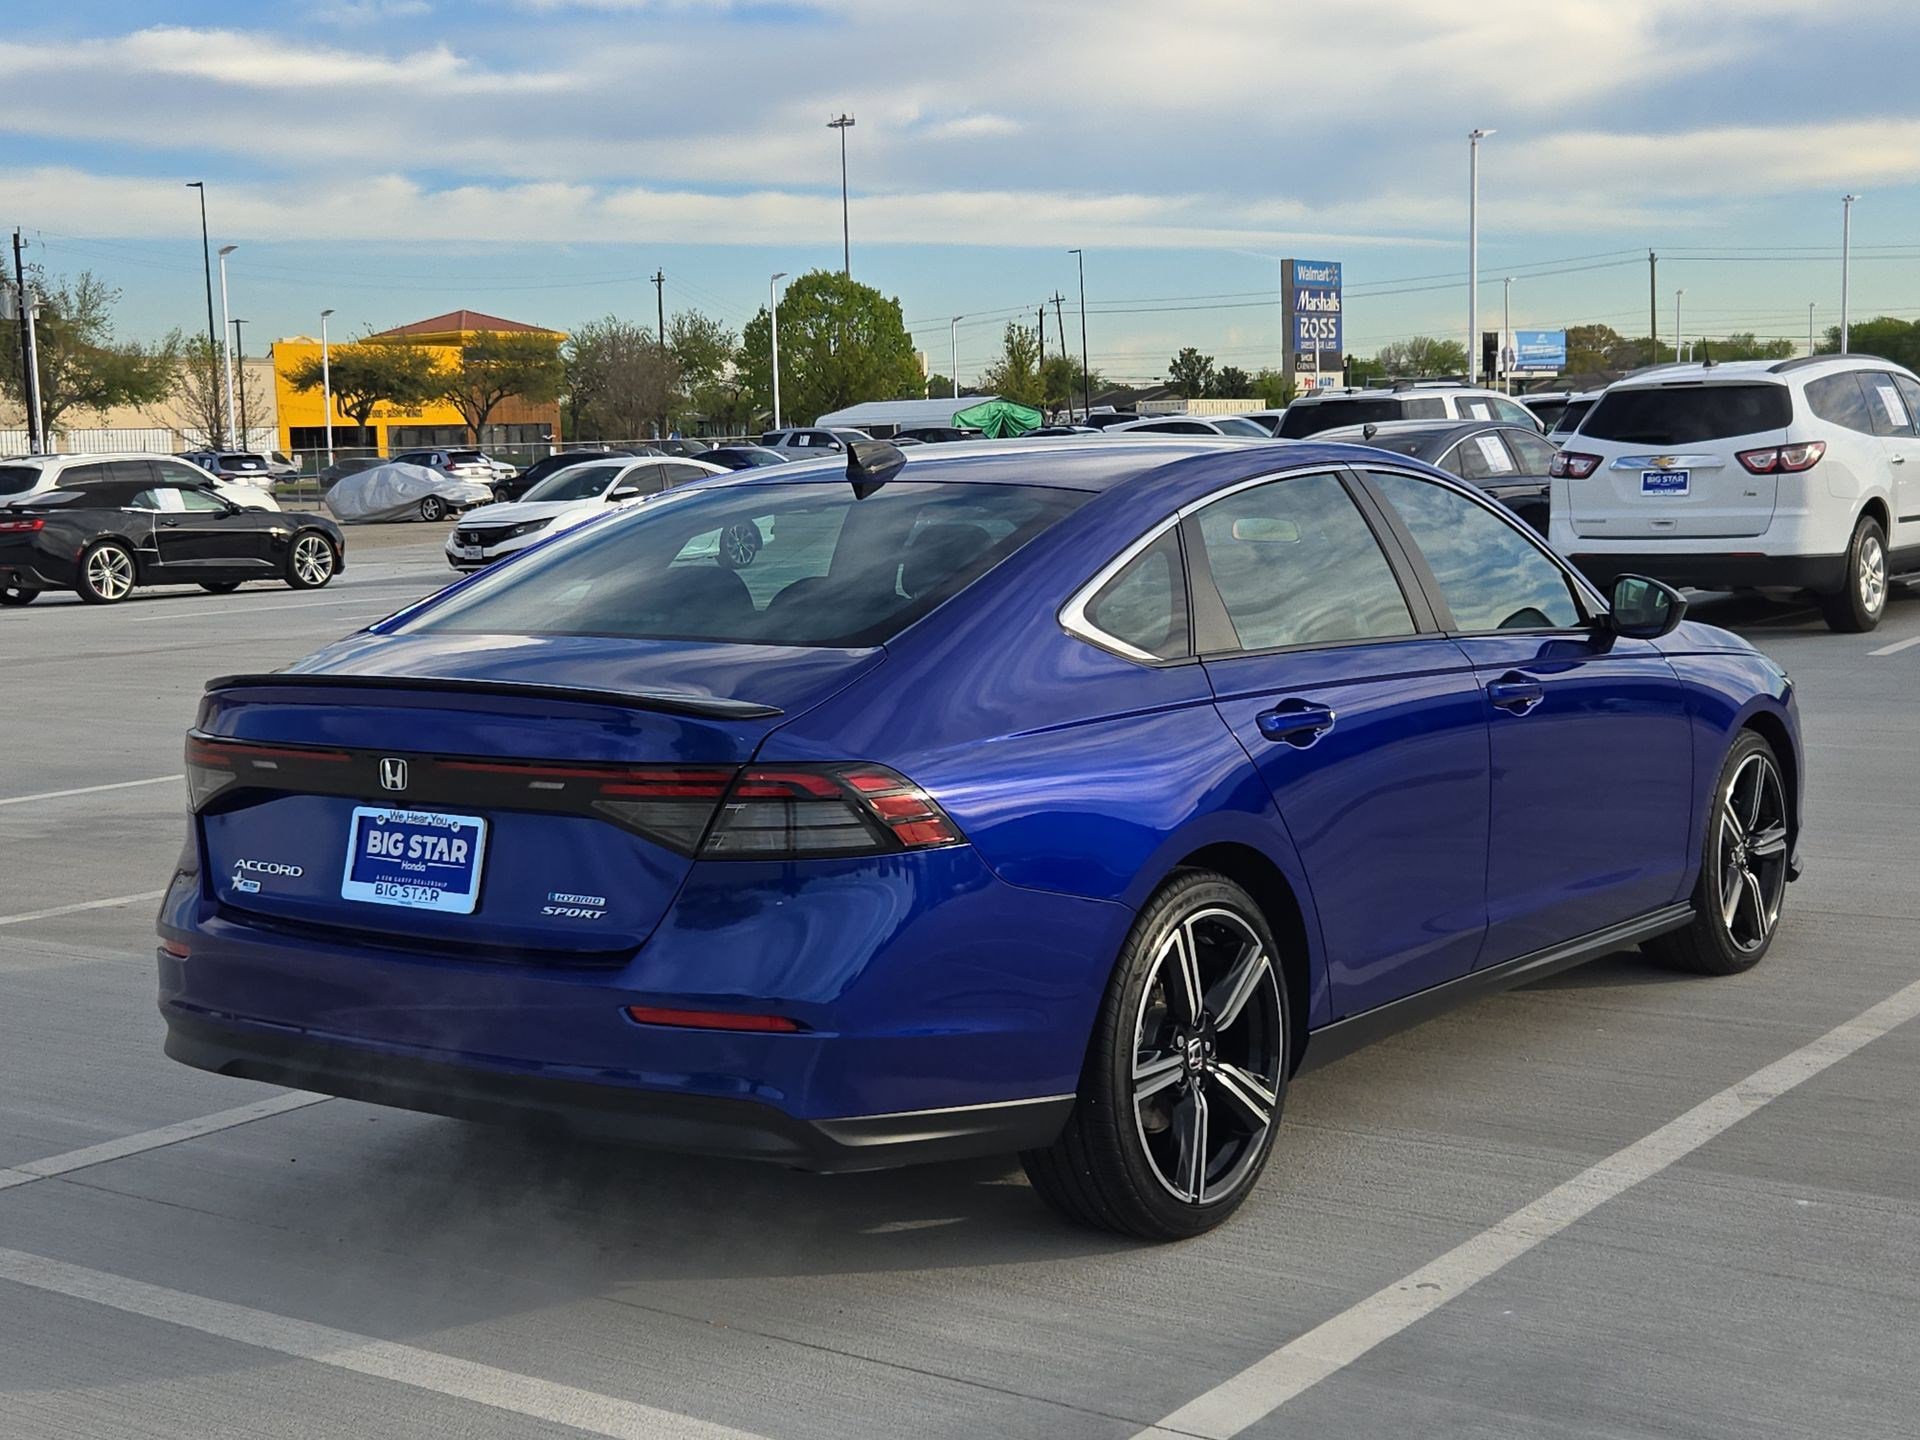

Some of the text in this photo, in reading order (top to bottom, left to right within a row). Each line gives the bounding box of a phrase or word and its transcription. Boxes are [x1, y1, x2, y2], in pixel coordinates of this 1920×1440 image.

[1298, 265, 1329, 281] Walmart
[1297, 291, 1339, 311] Marshalls
[1301, 317, 1336, 338] ROSS
[1662, 475, 1684, 483] STAR
[389, 810, 448, 827] We Hear You
[366, 830, 467, 863] BIG STAR
[234, 859, 303, 877] ACCORD
[400, 860, 426, 872] Honda
[375, 883, 440, 902] BIG STAR
[541, 906, 607, 919] SPORT
